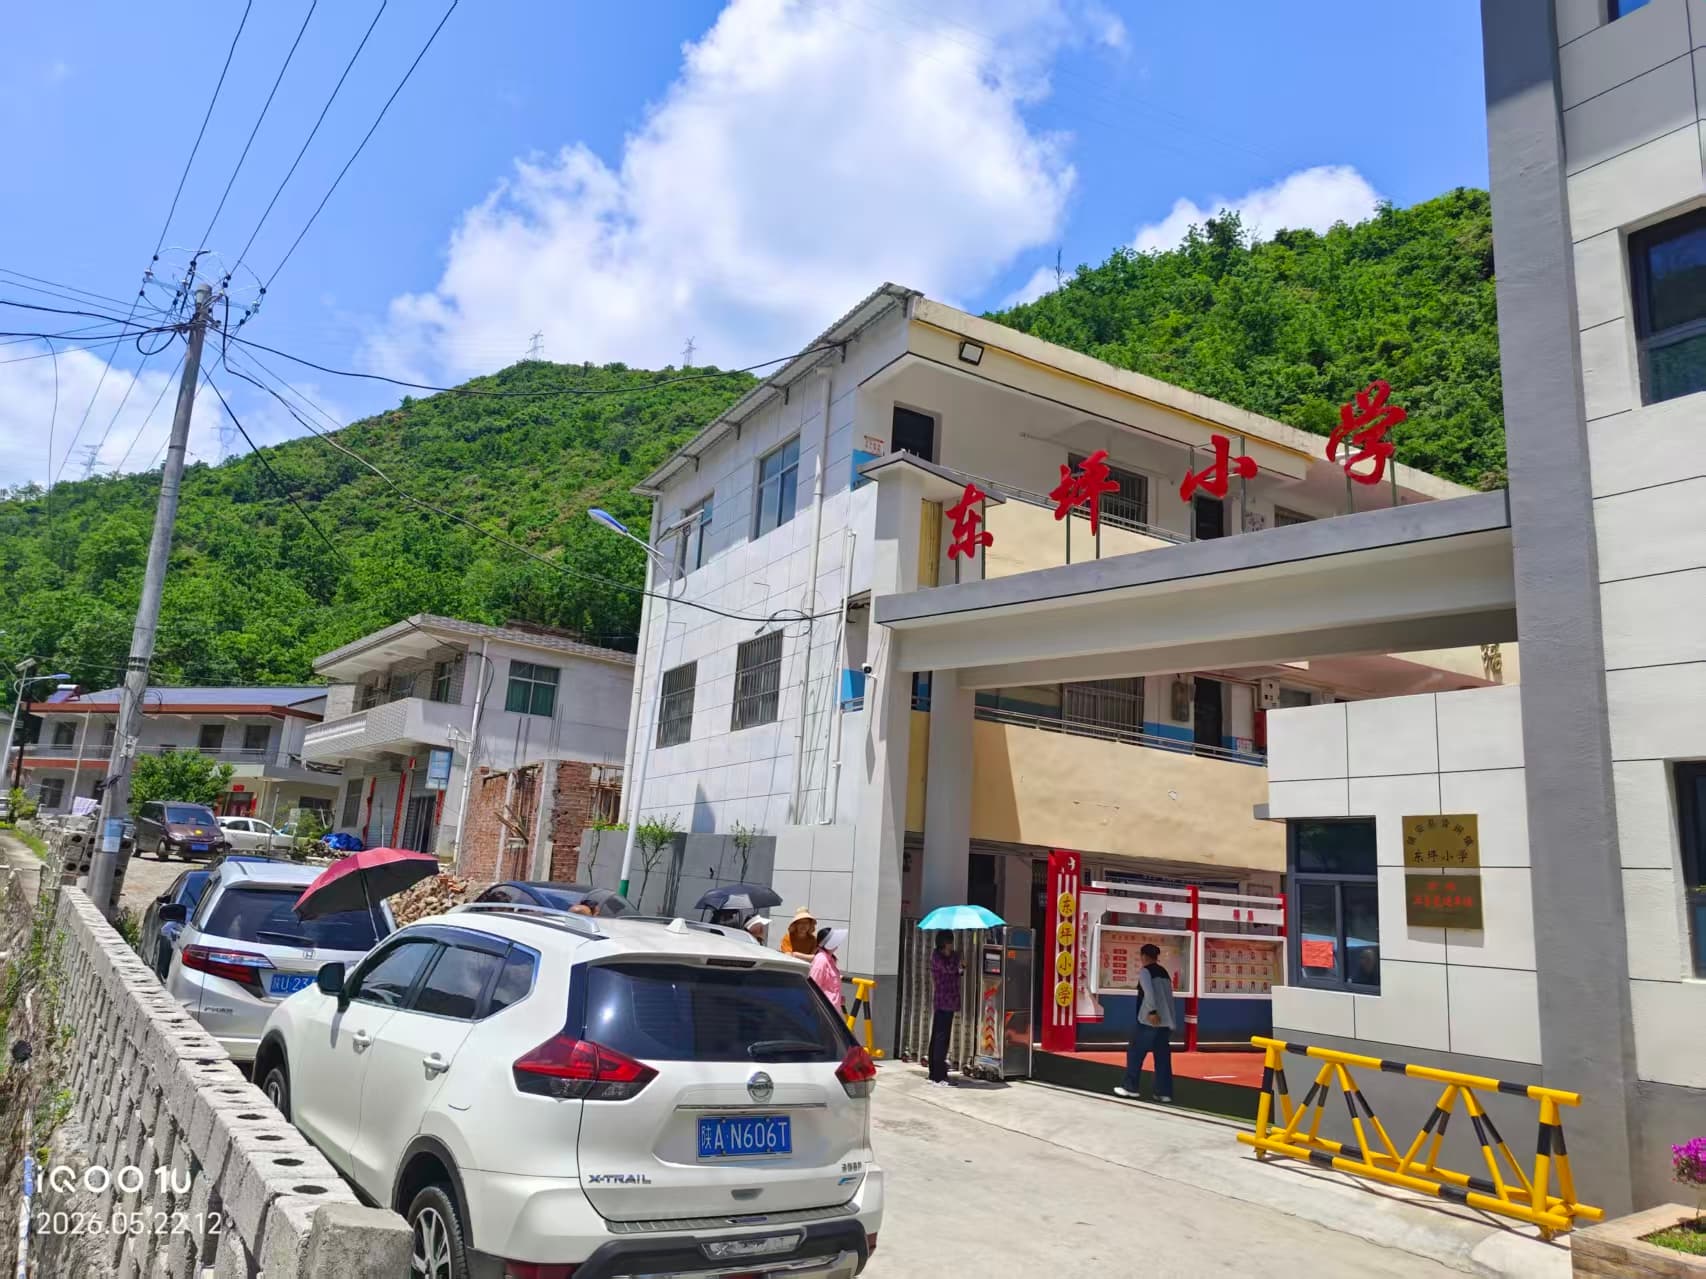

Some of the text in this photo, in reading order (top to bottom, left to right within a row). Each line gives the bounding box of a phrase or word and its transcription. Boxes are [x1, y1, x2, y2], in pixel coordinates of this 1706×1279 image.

[1057, 896, 1074, 1006] 东坪小学
[588, 1174, 652, 1184] X-TRAIL
